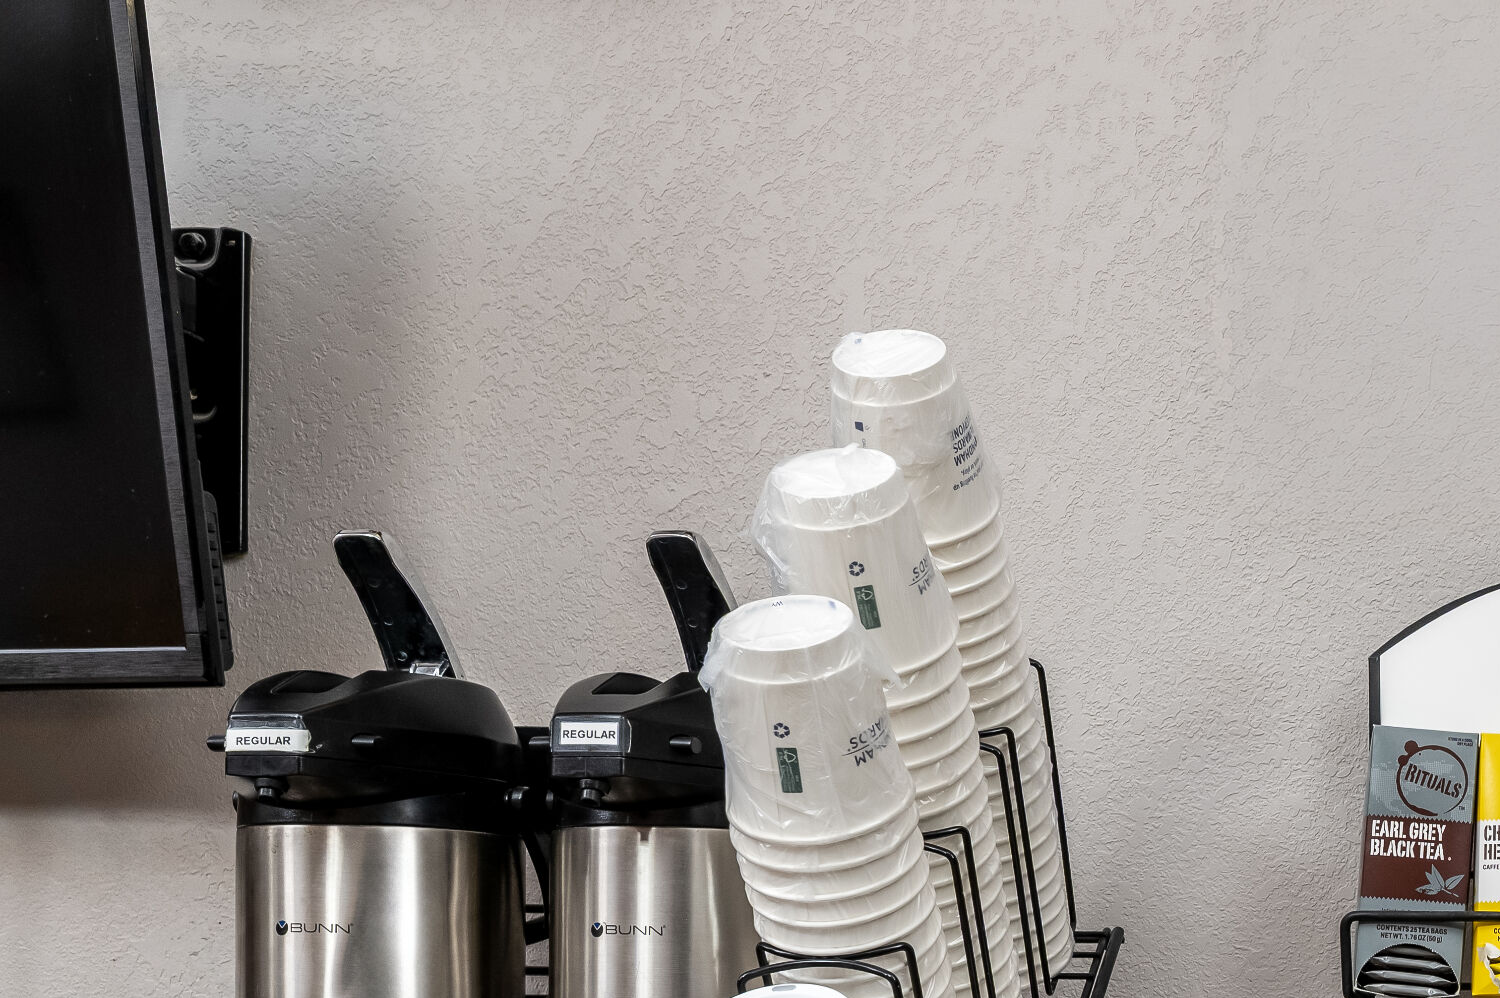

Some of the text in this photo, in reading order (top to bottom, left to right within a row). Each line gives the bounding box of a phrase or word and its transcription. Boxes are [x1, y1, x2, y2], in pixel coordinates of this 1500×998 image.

[562, 730, 616, 739] REGULAR
[236, 736, 291, 746] REGULAR
[1404, 763, 1462, 798] RITUALS
[1371, 820, 1446, 841] EARL GREY
[1370, 839, 1445, 860] BLACK TEA
[290, 923, 350, 933] BUNN
[606, 925, 663, 936] BUNN
[1376, 924, 1409, 932] CONTENTS
